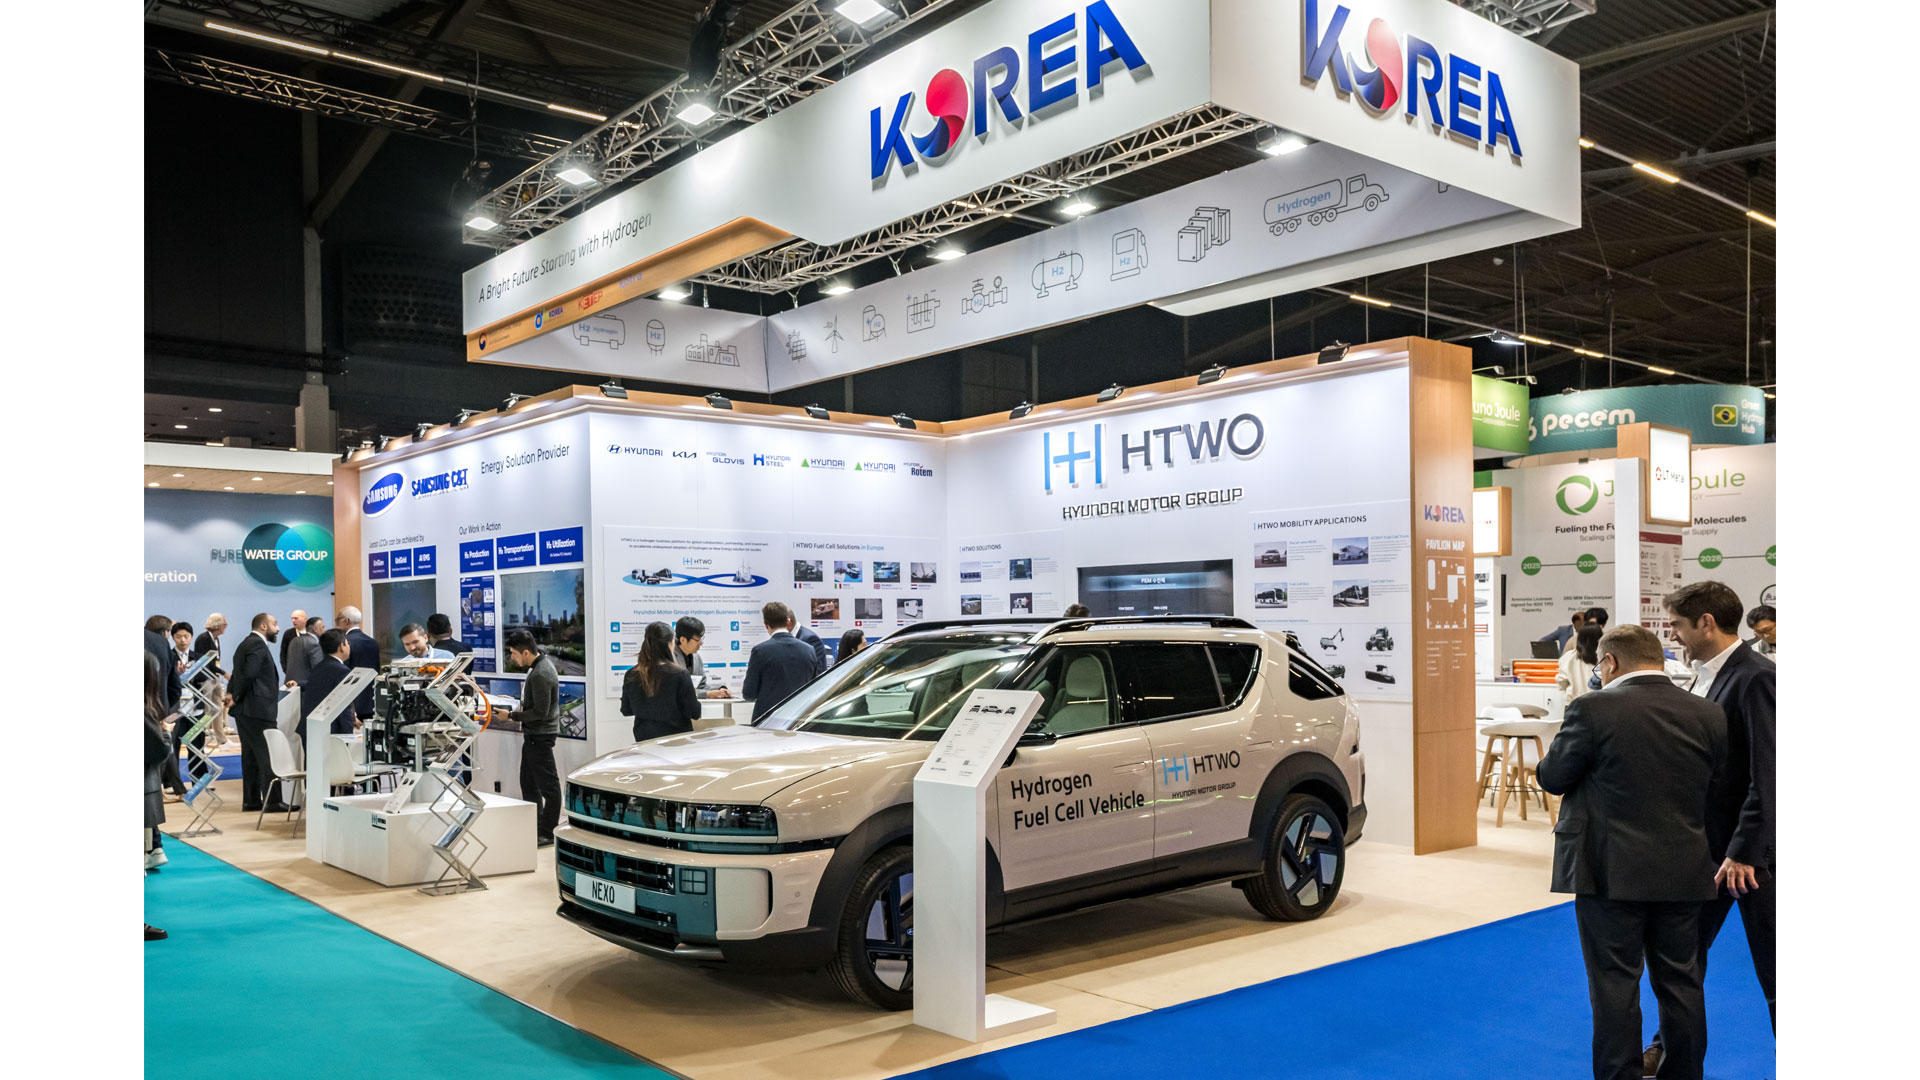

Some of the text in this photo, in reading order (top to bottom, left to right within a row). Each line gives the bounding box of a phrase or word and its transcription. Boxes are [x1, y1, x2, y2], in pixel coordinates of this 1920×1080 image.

[1301, 0, 1522, 158] KOREA
[870, 0, 1147, 180] KOREA
[1277, 191, 1331, 214] Hydrogen
[479, 211, 652, 303] A Bright Future Starting with Hydrogen
[1120, 257, 1131, 266] H2
[1052, 266, 1064, 276] H2
[578, 323, 591, 333] H2
[650, 331, 662, 340] H2
[1494, 402, 1521, 421] Joule
[1121, 413, 1264, 470] HTWO
[624, 447, 663, 456] HYUNDAI
[481, 443, 570, 474] Energy Solution Provider
[712, 457, 745, 465] GLOVIS
[811, 458, 845, 467] HYUNDAI
[863, 462, 896, 471] HYUNDAI
[911, 466, 933, 477] Rotem
[412, 473, 450, 496] SAMSUNG
[451, 468, 469, 487] C&T
[366, 483, 398, 504] SAMSUNG
[1063, 487, 1243, 520] HYUNDAI MOTOR GROUP
[1424, 504, 1465, 523] KOREA
[1694, 515, 1747, 525] Molecules
[459, 522, 501, 535] Our Work in Action
[1257, 515, 1367, 529] HTWO MOBILITY APPLICATIONS
[1555, 524, 1588, 533] Fueling
[1692, 528, 1718, 536] Supply
[504, 543, 535, 555] Transportation
[552, 538, 576, 548] Utilization
[1425, 538, 1465, 551] PAVILION MAP
[211, 549, 328, 563] PURE WATER GROUP
[469, 549, 489, 558] Production
[1523, 562, 1541, 570] 2025
[144, 570, 197, 583] eration
[1193, 750, 1241, 774] HTWO
[1011, 773, 1092, 802] Hydrogen
[1172, 781, 1237, 799] HYUNDAI MOTOR GROUP
[1014, 790, 1145, 830] Fuel Cell Vehicle
[591, 880, 615, 905] NEXO
